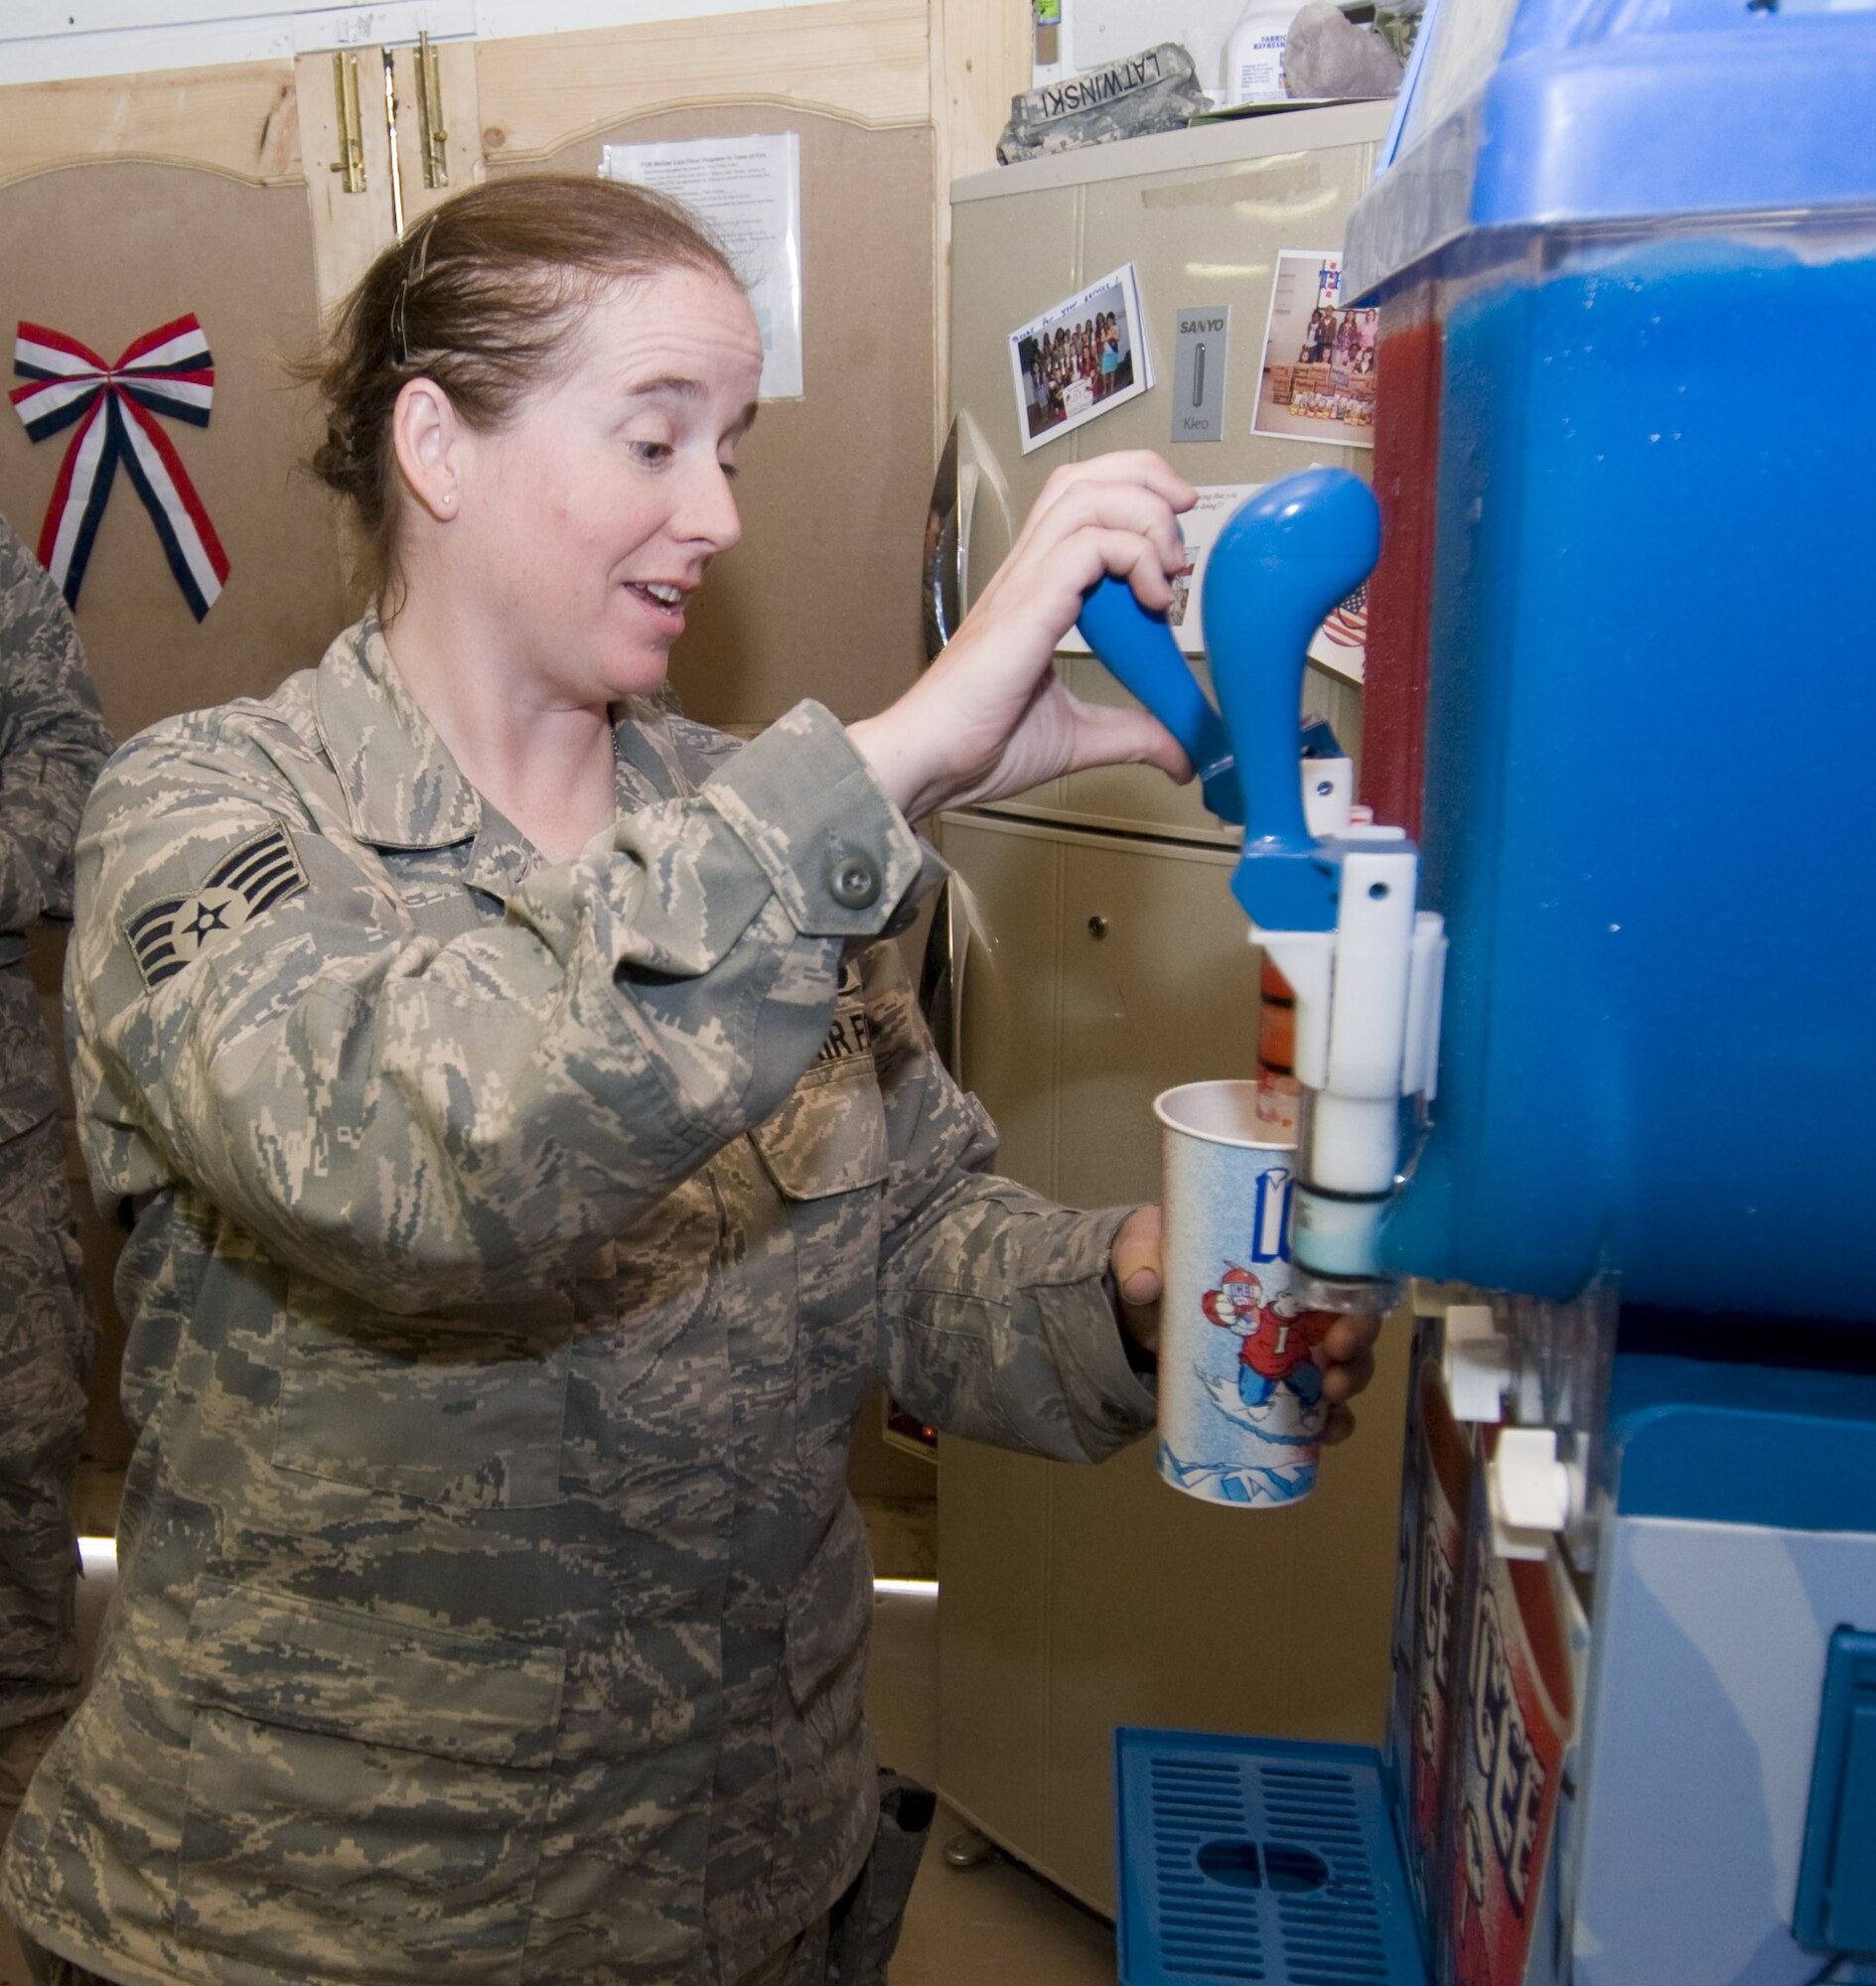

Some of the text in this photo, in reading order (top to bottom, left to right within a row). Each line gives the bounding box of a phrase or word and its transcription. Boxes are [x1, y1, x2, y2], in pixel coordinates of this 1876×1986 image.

[1042, 54, 1161, 117] LATWINSKI
[1180, 319, 1224, 334] SANYO
[1184, 417, 1209, 430] Kleo
[1467, 1537, 1548, 1918] ICEE
